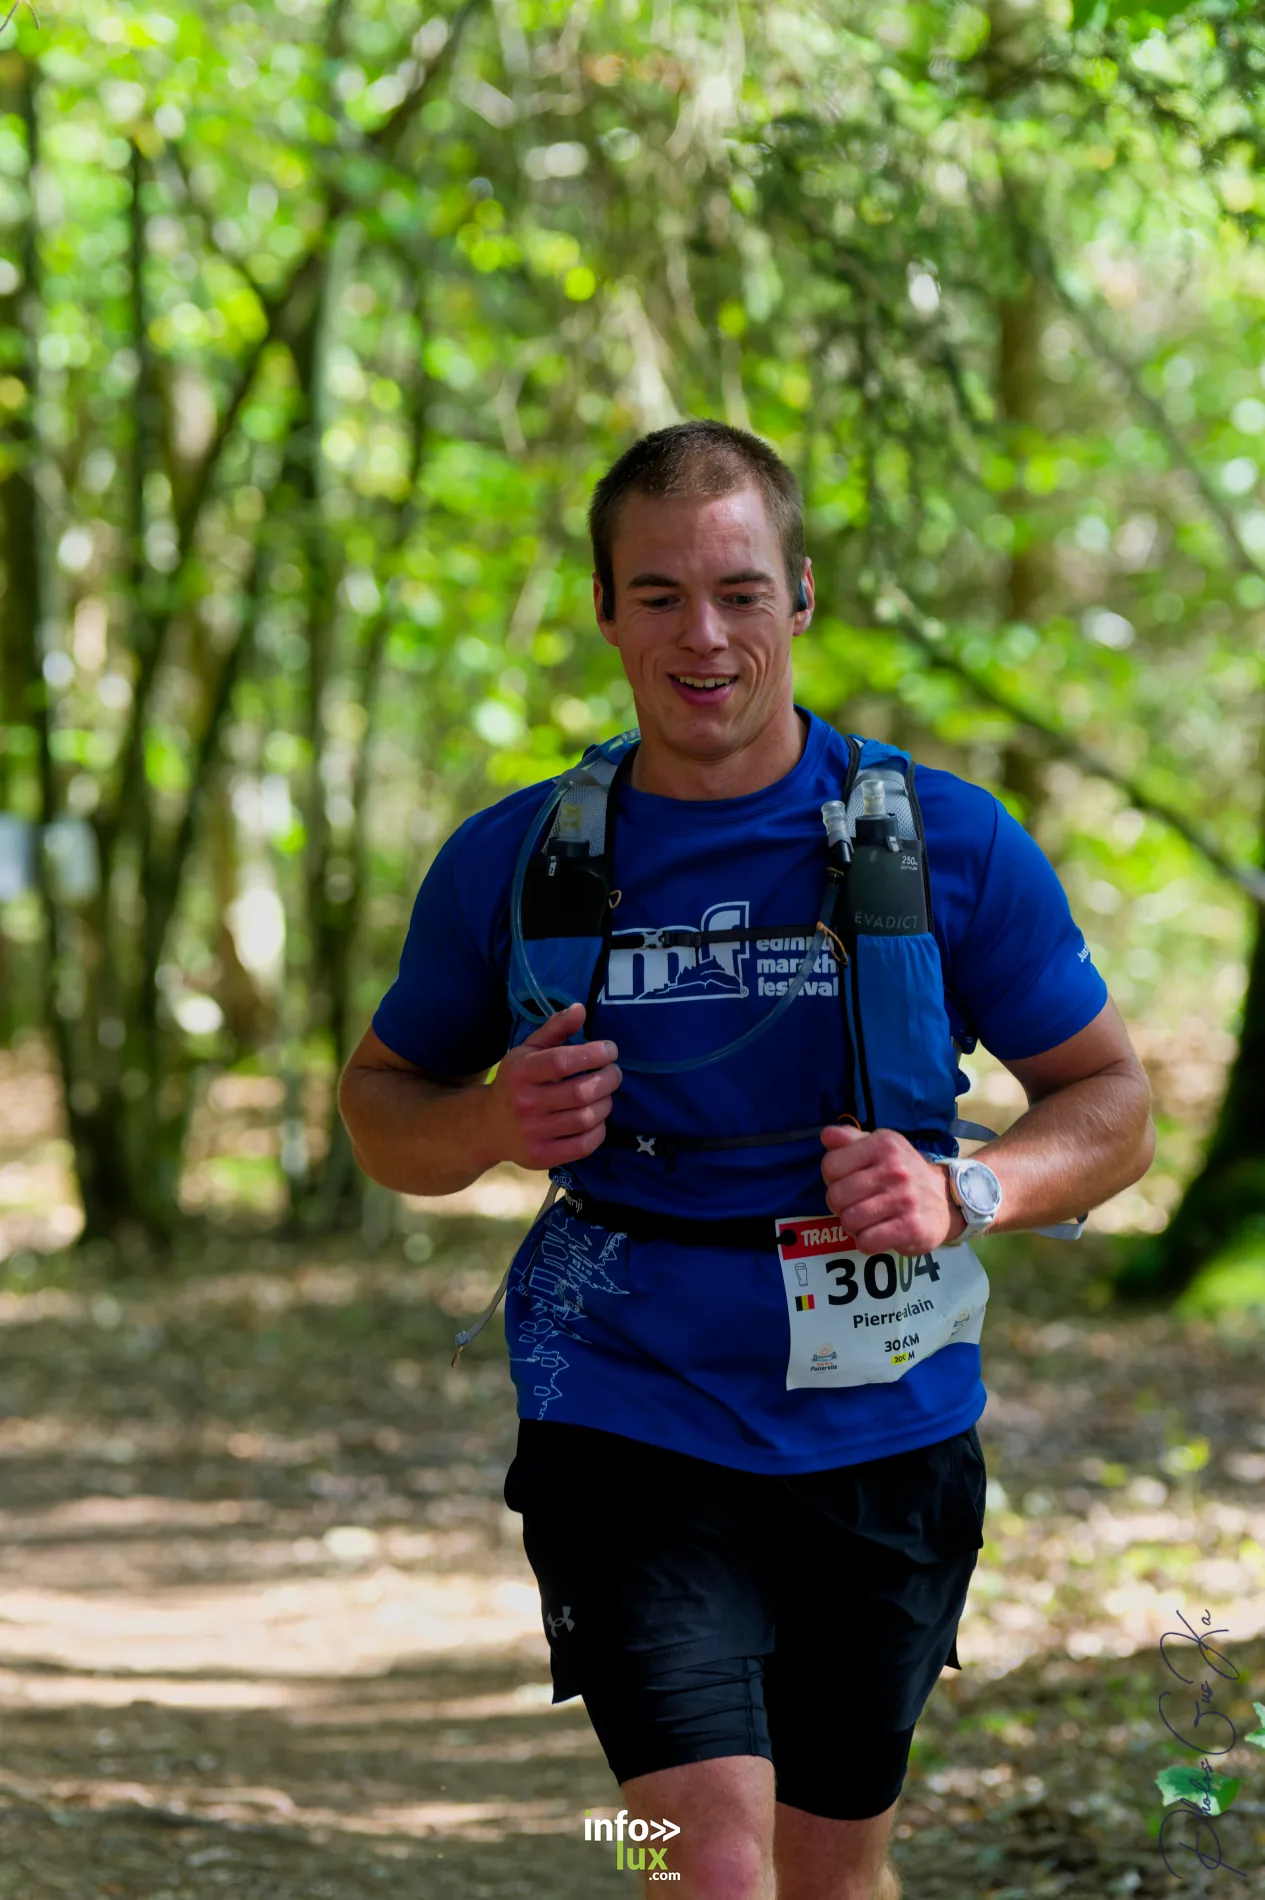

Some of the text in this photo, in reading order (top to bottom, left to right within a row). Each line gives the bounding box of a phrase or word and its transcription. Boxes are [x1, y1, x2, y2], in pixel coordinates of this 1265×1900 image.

[854, 910, 919, 929] EVADICT
[757, 976, 839, 997] fesval
[800, 1225, 849, 1247] TRAIL
[825, 1252, 941, 1305] 3004
